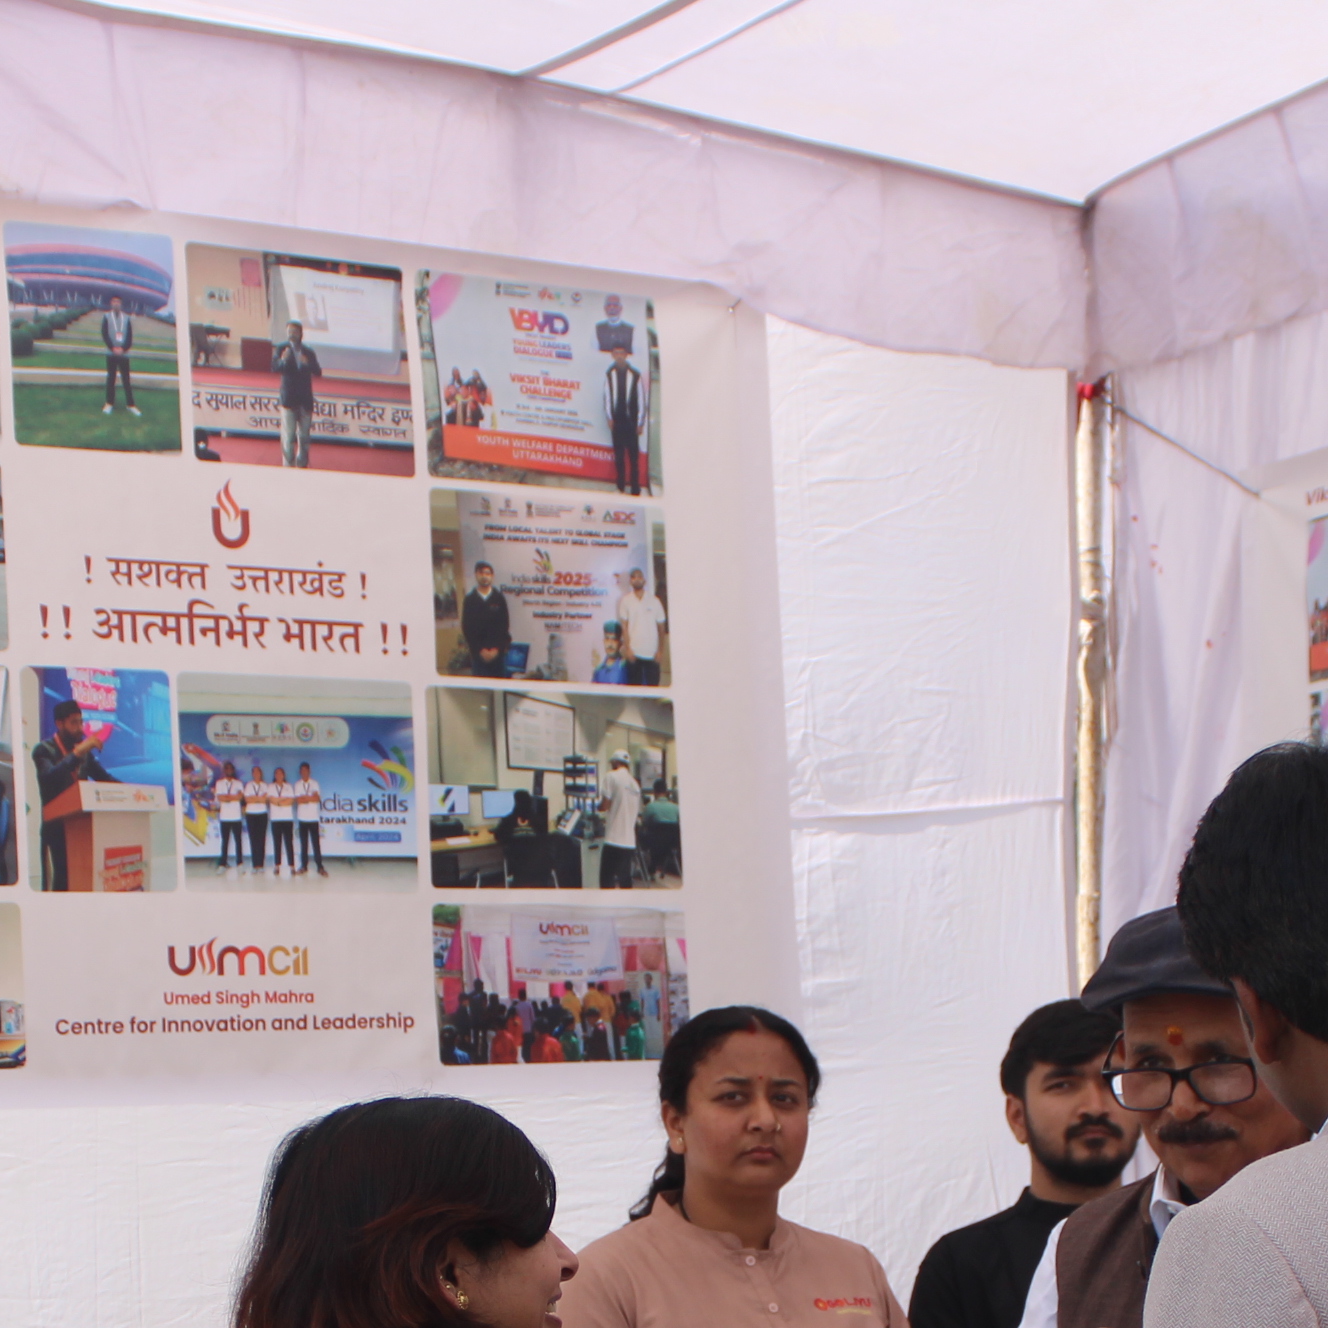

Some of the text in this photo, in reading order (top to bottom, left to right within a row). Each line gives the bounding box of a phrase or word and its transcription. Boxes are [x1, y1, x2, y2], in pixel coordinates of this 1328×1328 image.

[509, 371, 581, 390] VIKSIT BHARAT
[520, 383, 572, 400] CHALLENGE
[476, 434, 510, 446] YOUTH
[512, 438, 554, 451] WELFARE
[512, 449, 583, 468] UTTARAKHAND
[106, 556, 210, 591] सशक्त
[225, 560, 347, 600] उत्तराखंड
[499, 584, 609, 599] Regional Competition
[91, 599, 271, 650] आत्मनिर्भर
[276, 616, 365, 655] भारत
[357, 793, 409, 812] skills
[378, 816, 407, 825] 2024
[163, 989, 315, 1009] Umed Singh Mahra
[55, 1012, 415, 1036] Centre for Innovation and Leadership
